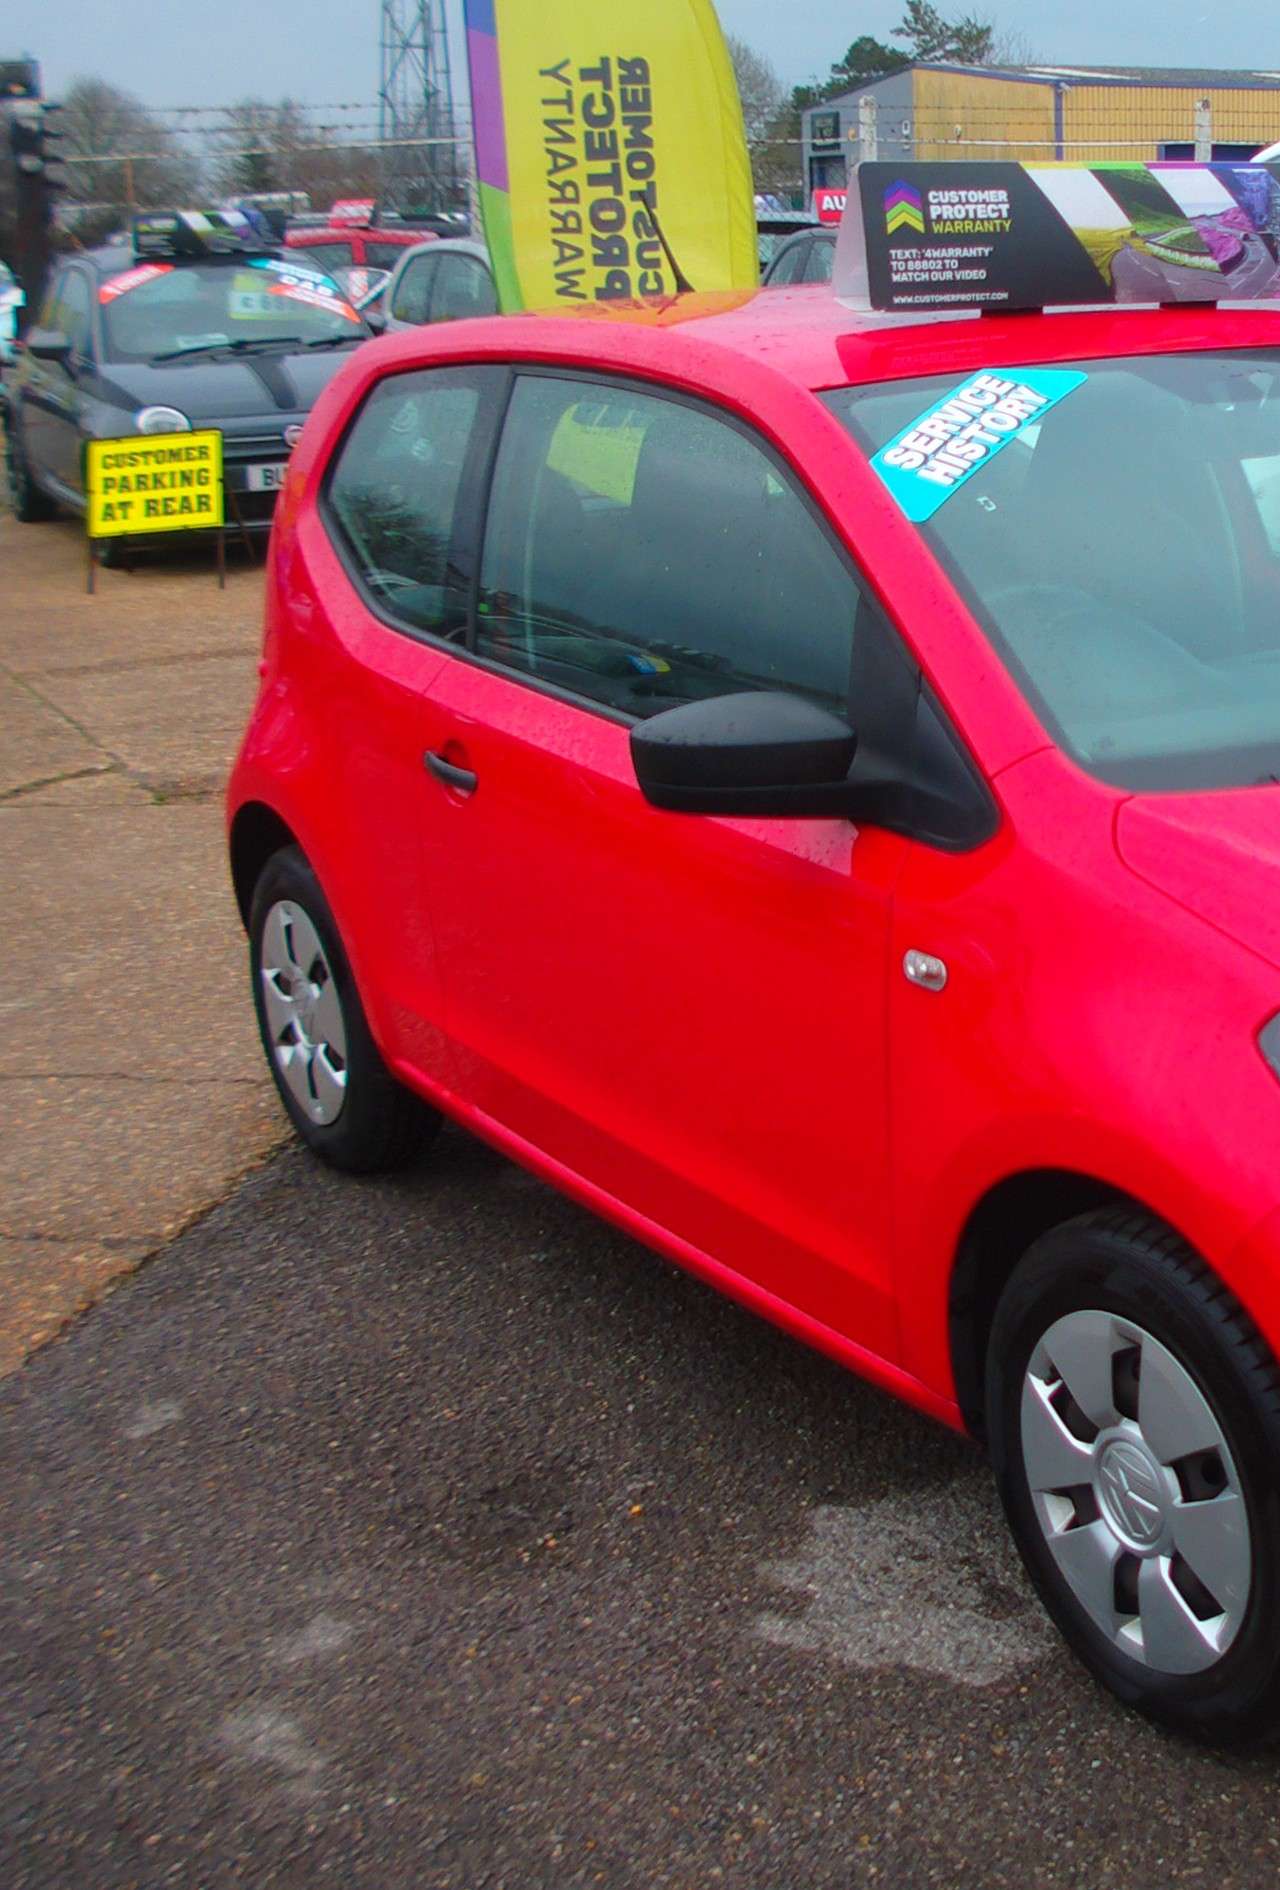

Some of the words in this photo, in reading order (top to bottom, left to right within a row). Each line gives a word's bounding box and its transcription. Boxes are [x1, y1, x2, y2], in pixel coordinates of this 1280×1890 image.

[928, 190, 1008, 204] CUSTOMER
[929, 204, 1010, 219] PROTECT
[932, 219, 1012, 234] WARRANTY
[889, 249, 921, 260] TEXT:
[890, 261, 906, 271] TO
[945, 259, 959, 269] TO
[891, 271, 929, 283] WATCH
[931, 271, 954, 281] OUR
[955, 269, 987, 280] VIDEO
[882, 374, 1016, 470] SERVICE
[916, 384, 1050, 488] HISTORY
[101, 445, 211, 471] CUSTOMER
[101, 468, 211, 496] PARKING
[101, 500, 135, 522] AT
[143, 494, 212, 518] REAR
